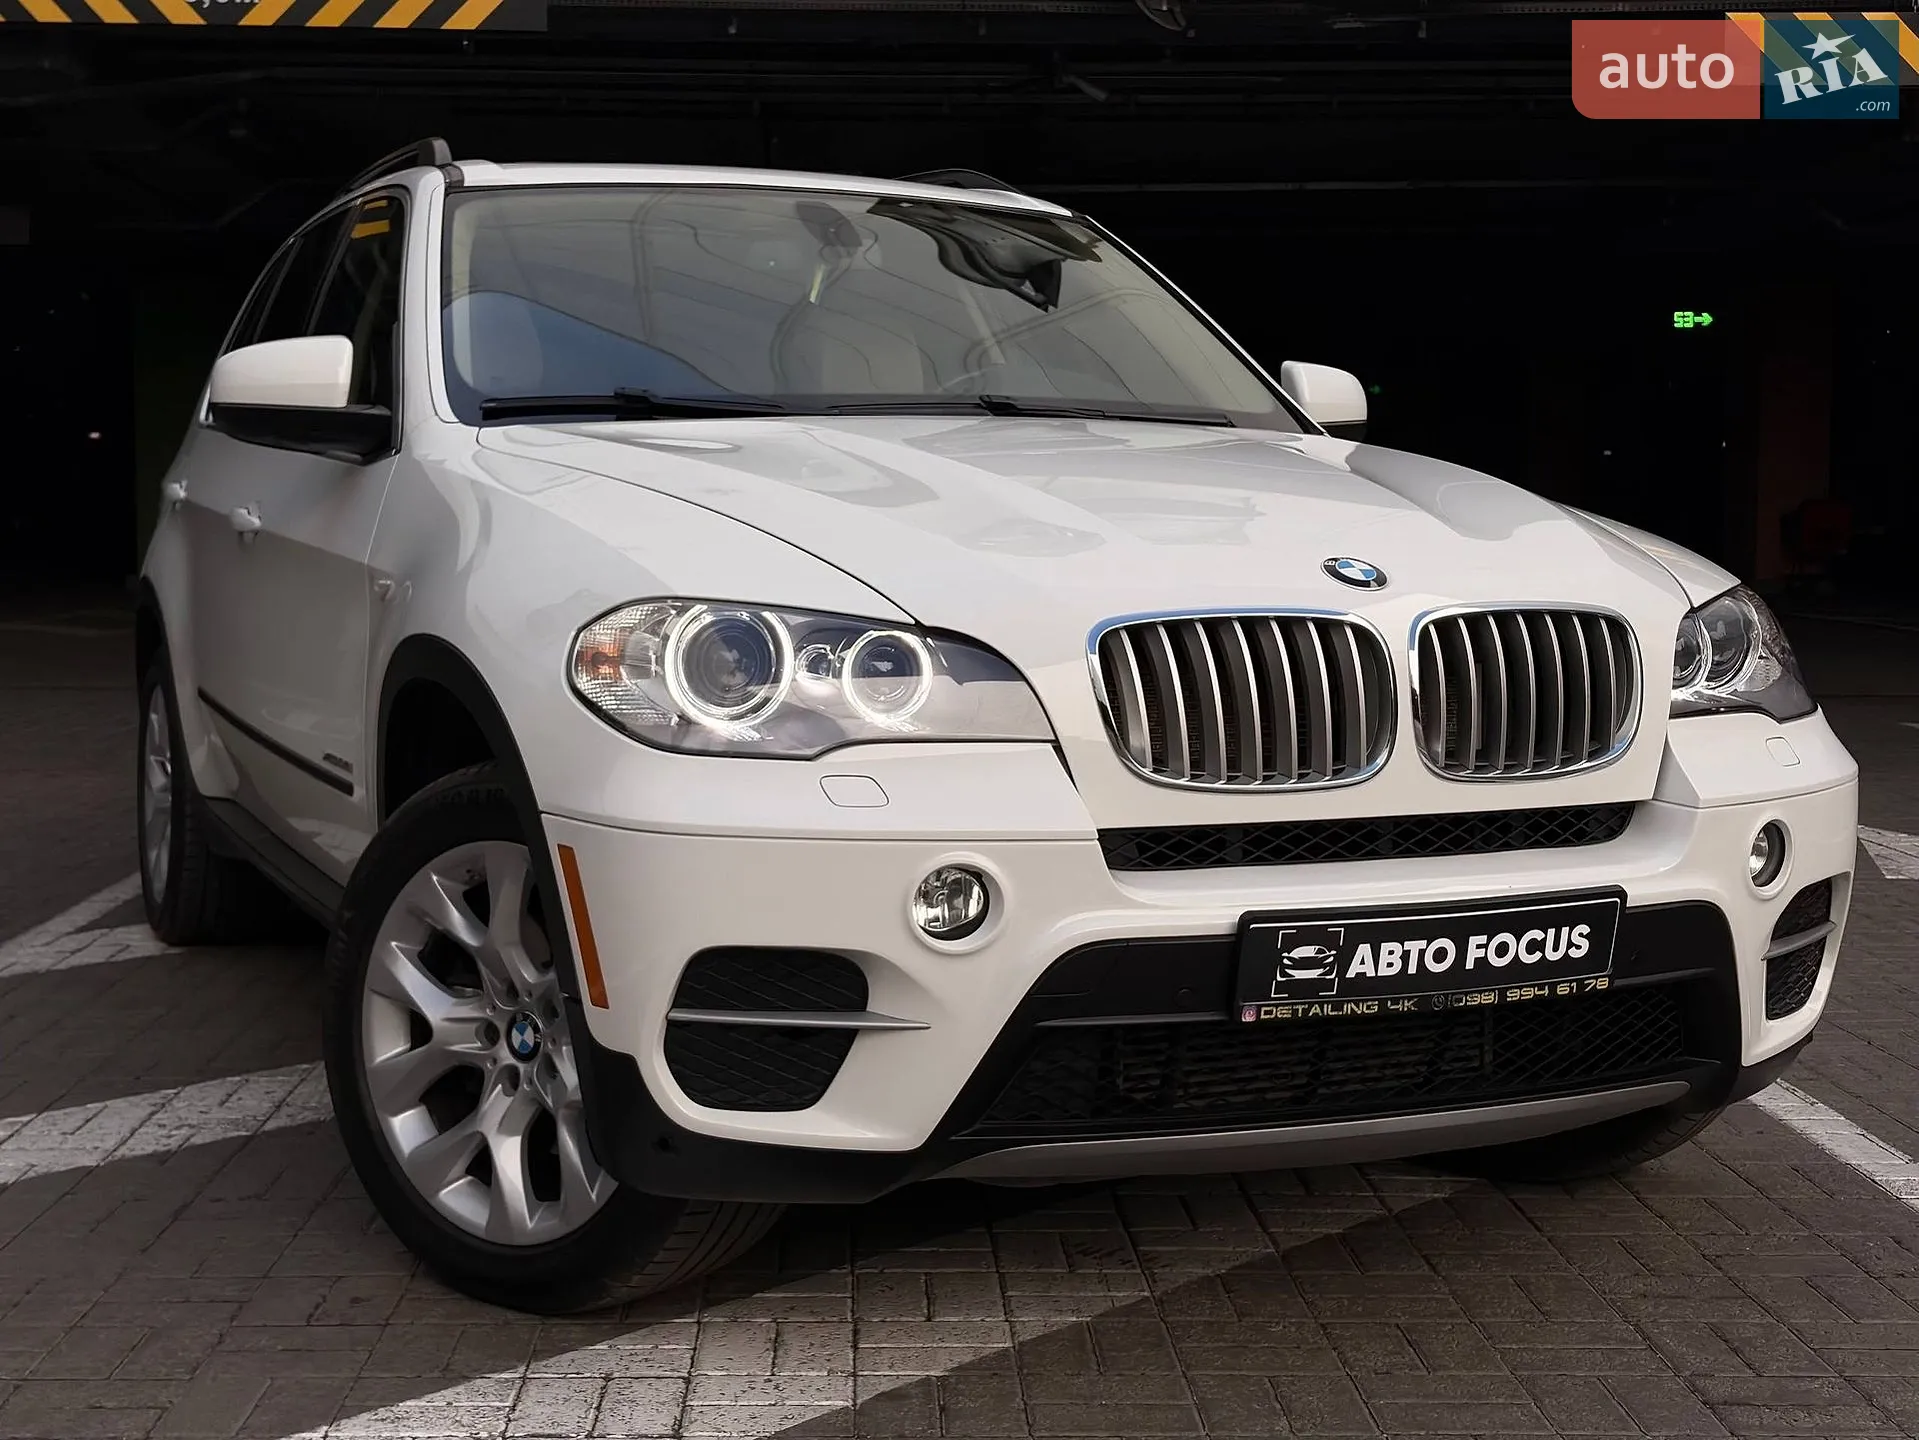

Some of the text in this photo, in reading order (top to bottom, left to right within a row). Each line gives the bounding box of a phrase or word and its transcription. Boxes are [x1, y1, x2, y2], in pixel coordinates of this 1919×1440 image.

[1465, 924, 1591, 969] FOCUS
[1260, 1000, 1379, 1019] DETAILING
[1506, 985, 1550, 1001] 994
[1556, 981, 1578, 995] 61
[1583, 977, 1609, 992] 78
